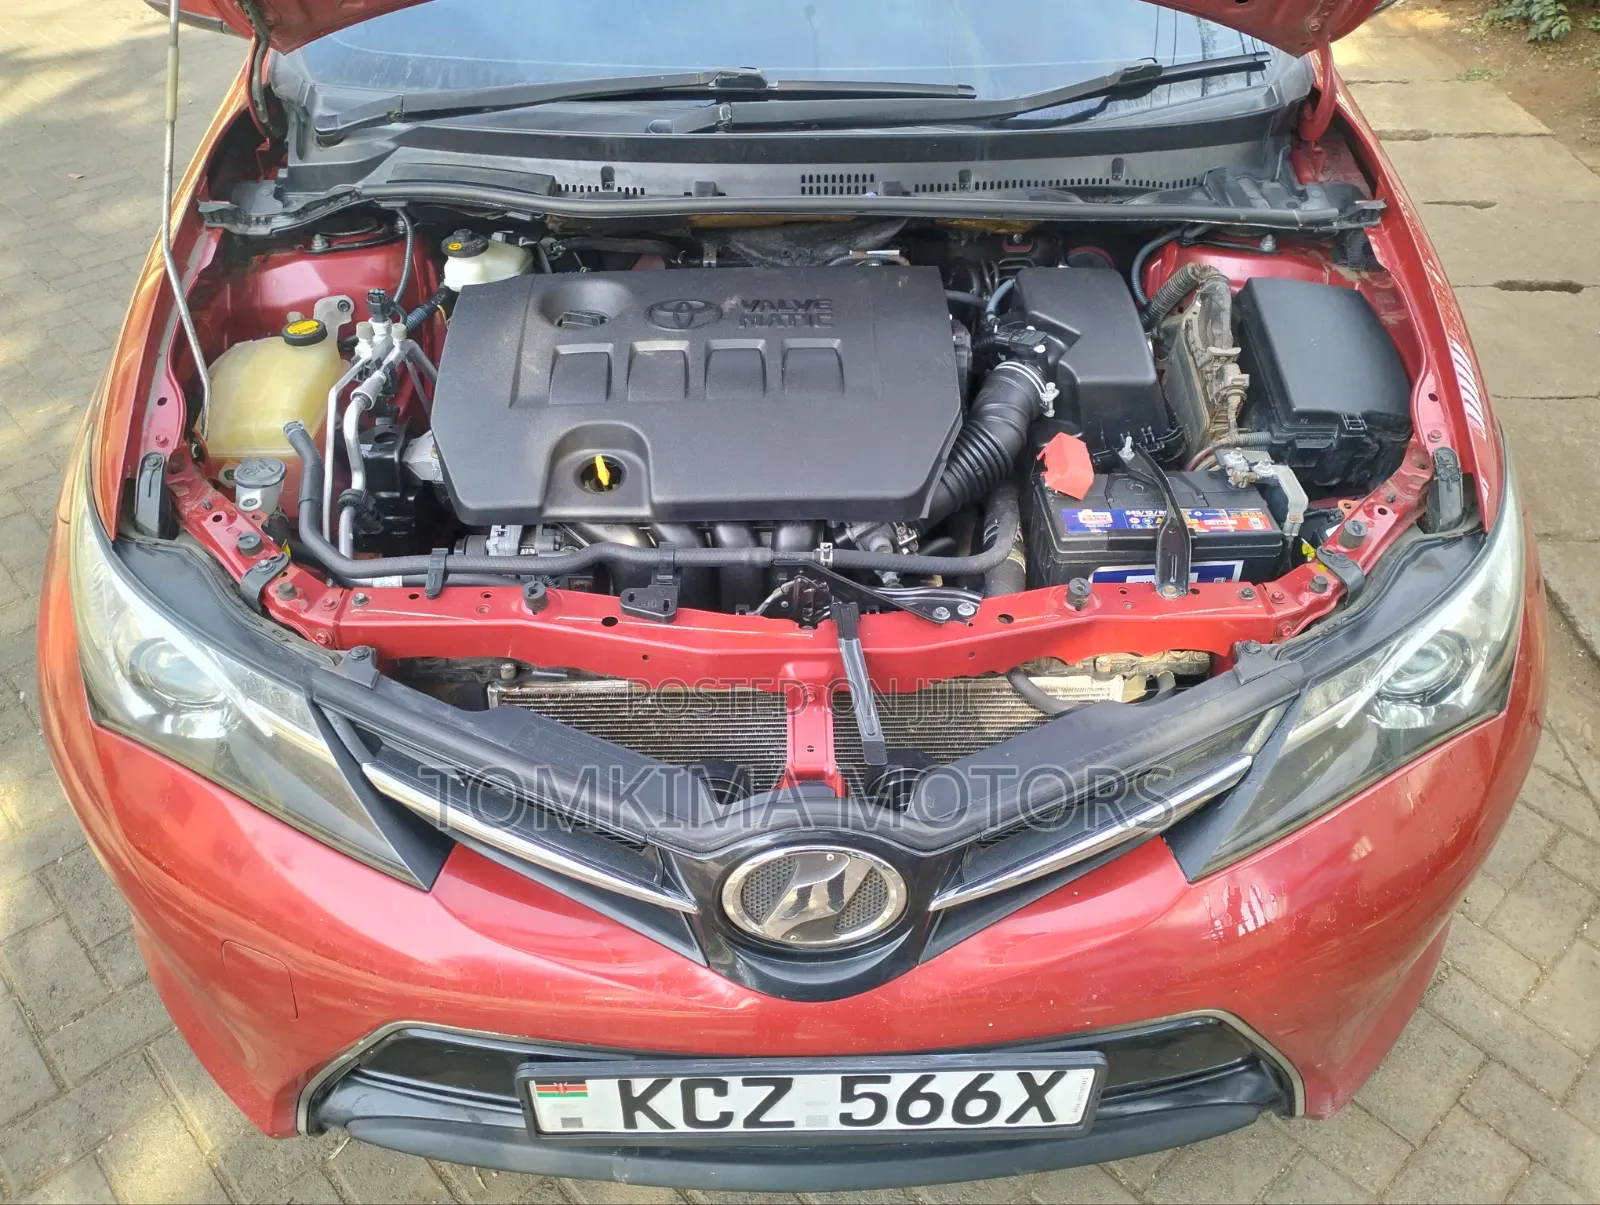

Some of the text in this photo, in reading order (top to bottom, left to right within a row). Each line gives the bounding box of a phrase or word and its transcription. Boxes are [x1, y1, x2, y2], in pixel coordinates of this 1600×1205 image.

[741, 299, 832, 313] VALVE
[617, 1077, 795, 1130] KCZ
[839, 1071, 1067, 1127] 566X
